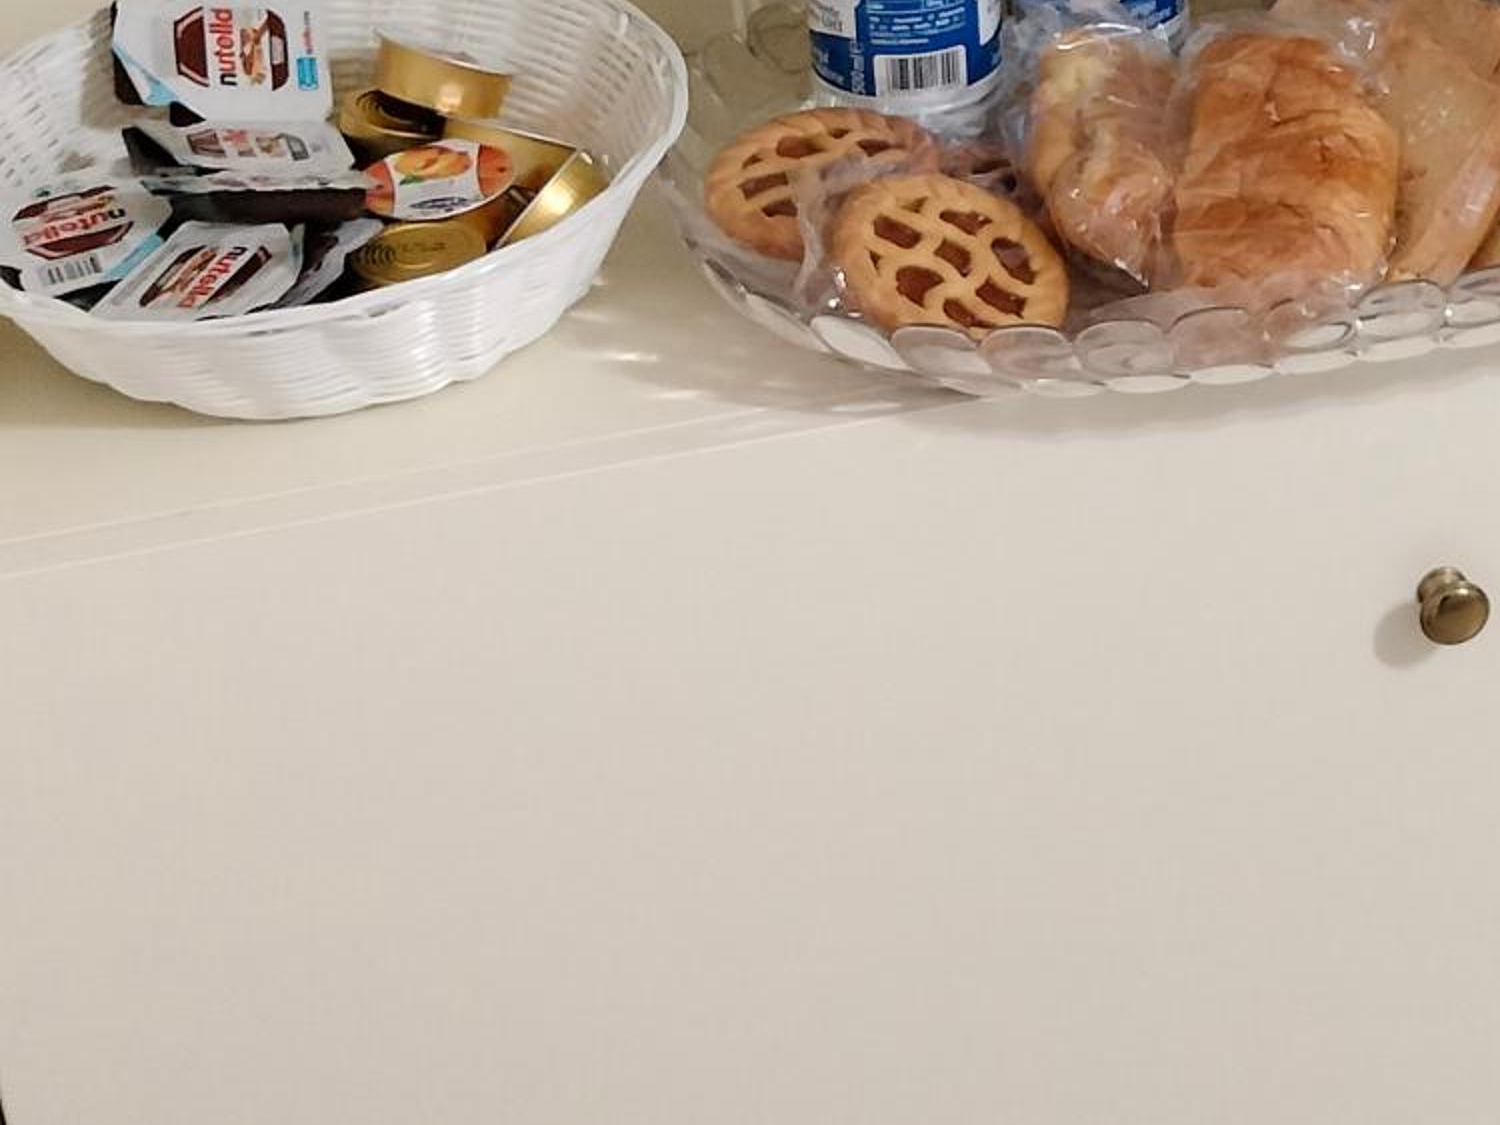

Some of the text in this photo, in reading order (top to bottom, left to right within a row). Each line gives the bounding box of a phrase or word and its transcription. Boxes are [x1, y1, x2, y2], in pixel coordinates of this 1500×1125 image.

[208, 7, 238, 87] nutella
[23, 207, 127, 246] nutella
[176, 246, 248, 309] nutella
